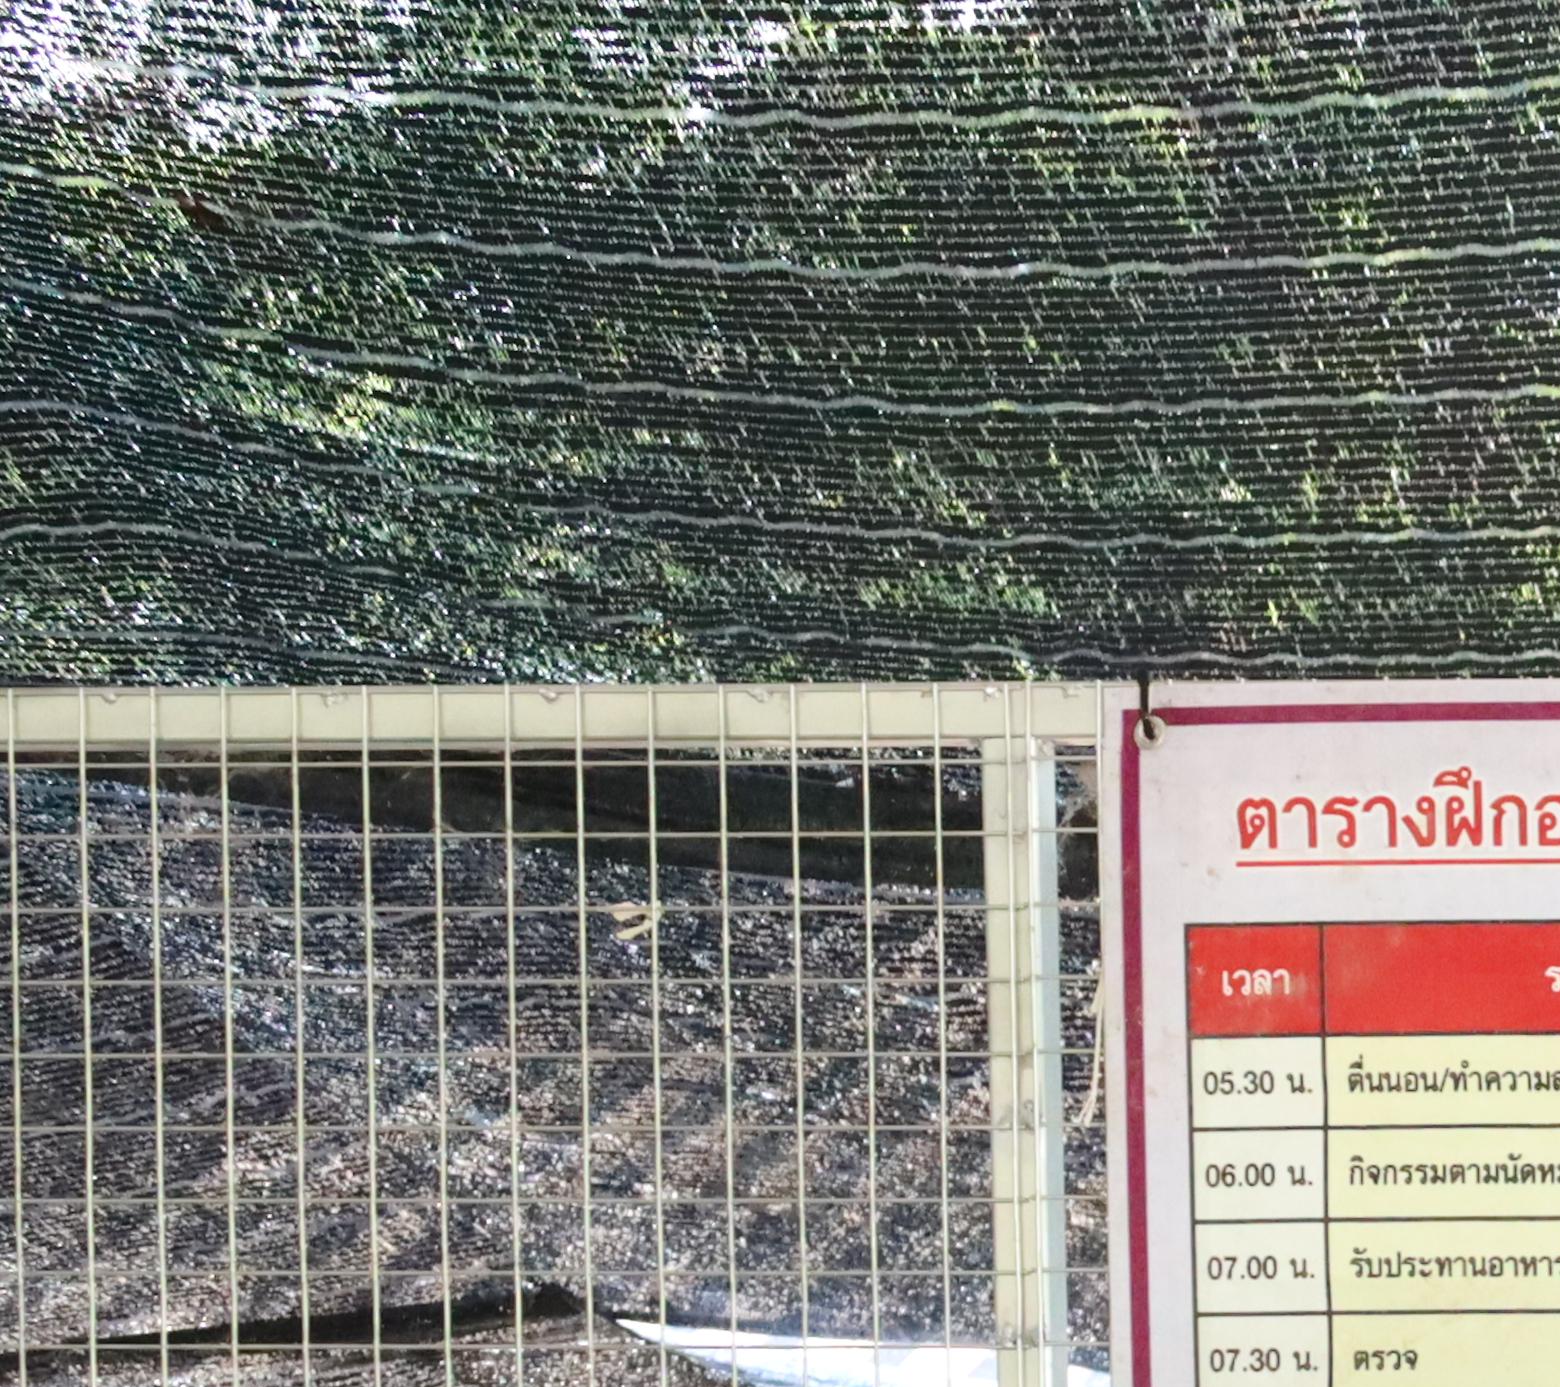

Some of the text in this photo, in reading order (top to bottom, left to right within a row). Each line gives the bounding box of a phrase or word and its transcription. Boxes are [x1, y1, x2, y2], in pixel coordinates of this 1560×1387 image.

[1221, 968, 1293, 997] เวลา
[1203, 1070, 1313, 1096] 05.30 น.
[1205, 1162, 1313, 1188] 06.00 น.
[1207, 1255, 1315, 1281] 07.00 น.
[1209, 1347, 1318, 1373] 07.30 น.
[1353, 1349, 1419, 1371] ตรวจ
